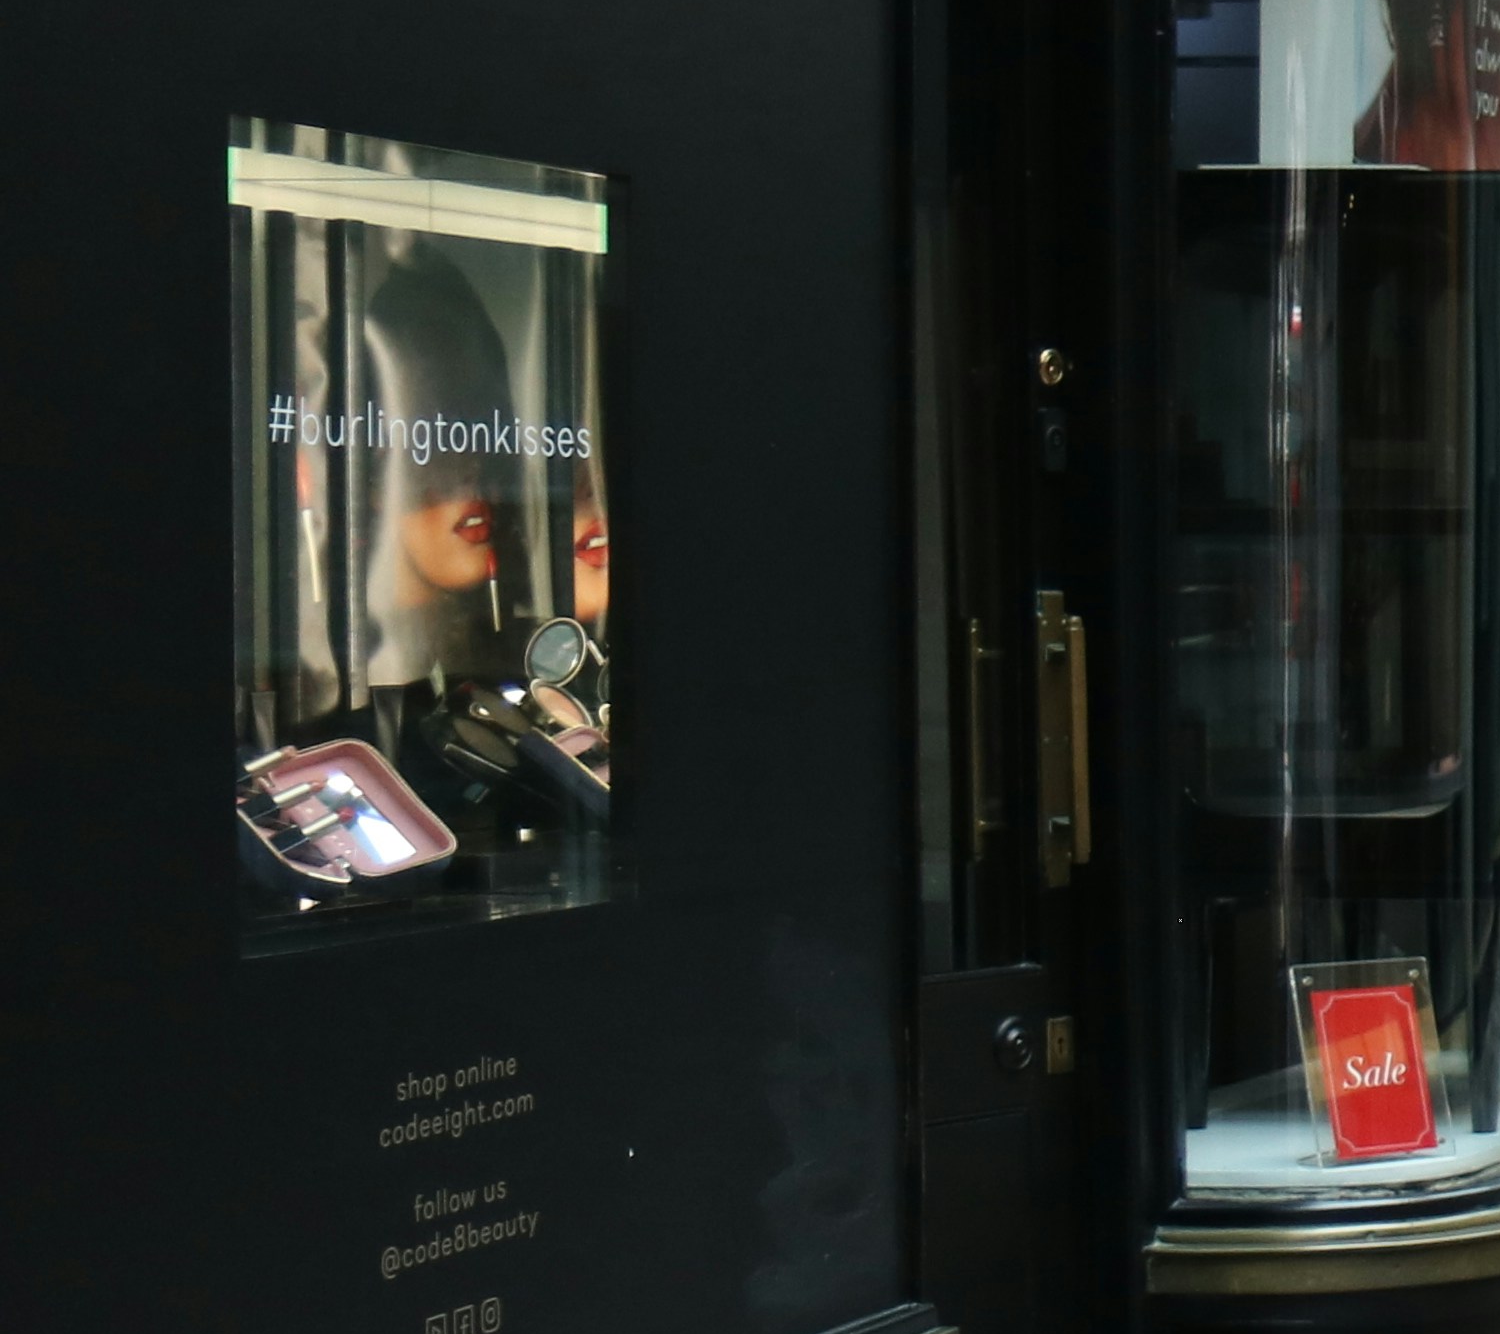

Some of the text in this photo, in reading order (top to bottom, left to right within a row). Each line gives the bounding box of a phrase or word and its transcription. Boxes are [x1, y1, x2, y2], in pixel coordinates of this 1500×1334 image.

[1475, 90, 1500, 121] you
[268, 393, 593, 466] #burlingtonkisses
[396, 1056, 518, 1102] shop online
[1343, 1051, 1407, 1089] Sale
[379, 1093, 535, 1147] codeeight.com
[414, 1180, 508, 1223] follow us
[380, 1210, 541, 1280] @code8beauty
